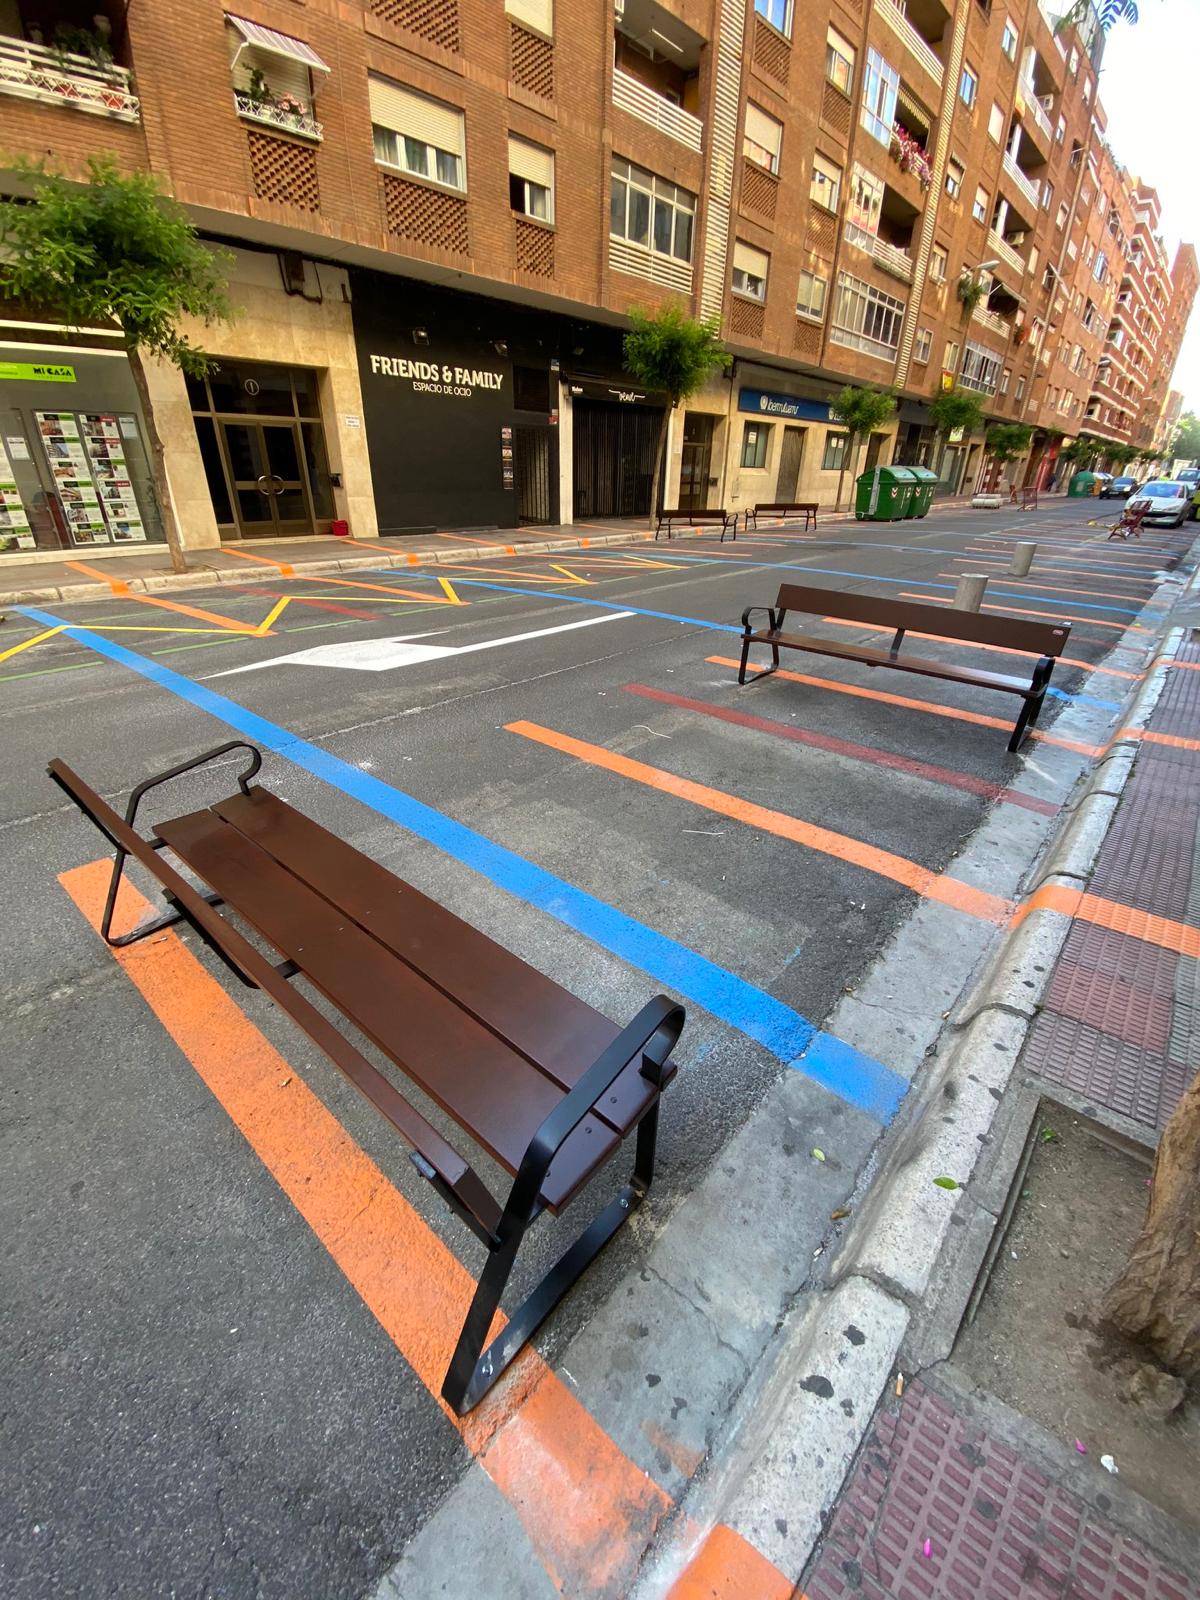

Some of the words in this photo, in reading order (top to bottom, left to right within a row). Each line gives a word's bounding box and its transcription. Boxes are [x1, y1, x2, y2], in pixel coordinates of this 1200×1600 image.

[32, 367, 46, 375] MI
[46, 367, 73, 377] CASA
[370, 354, 439, 381] FRIENDS
[442, 365, 453, 383] &
[454, 367, 504, 390] FAMILY
[412, 381, 443, 393] ESPACIO
[443, 385, 453, 395] DE
[453, 387, 472, 397] OCIO
